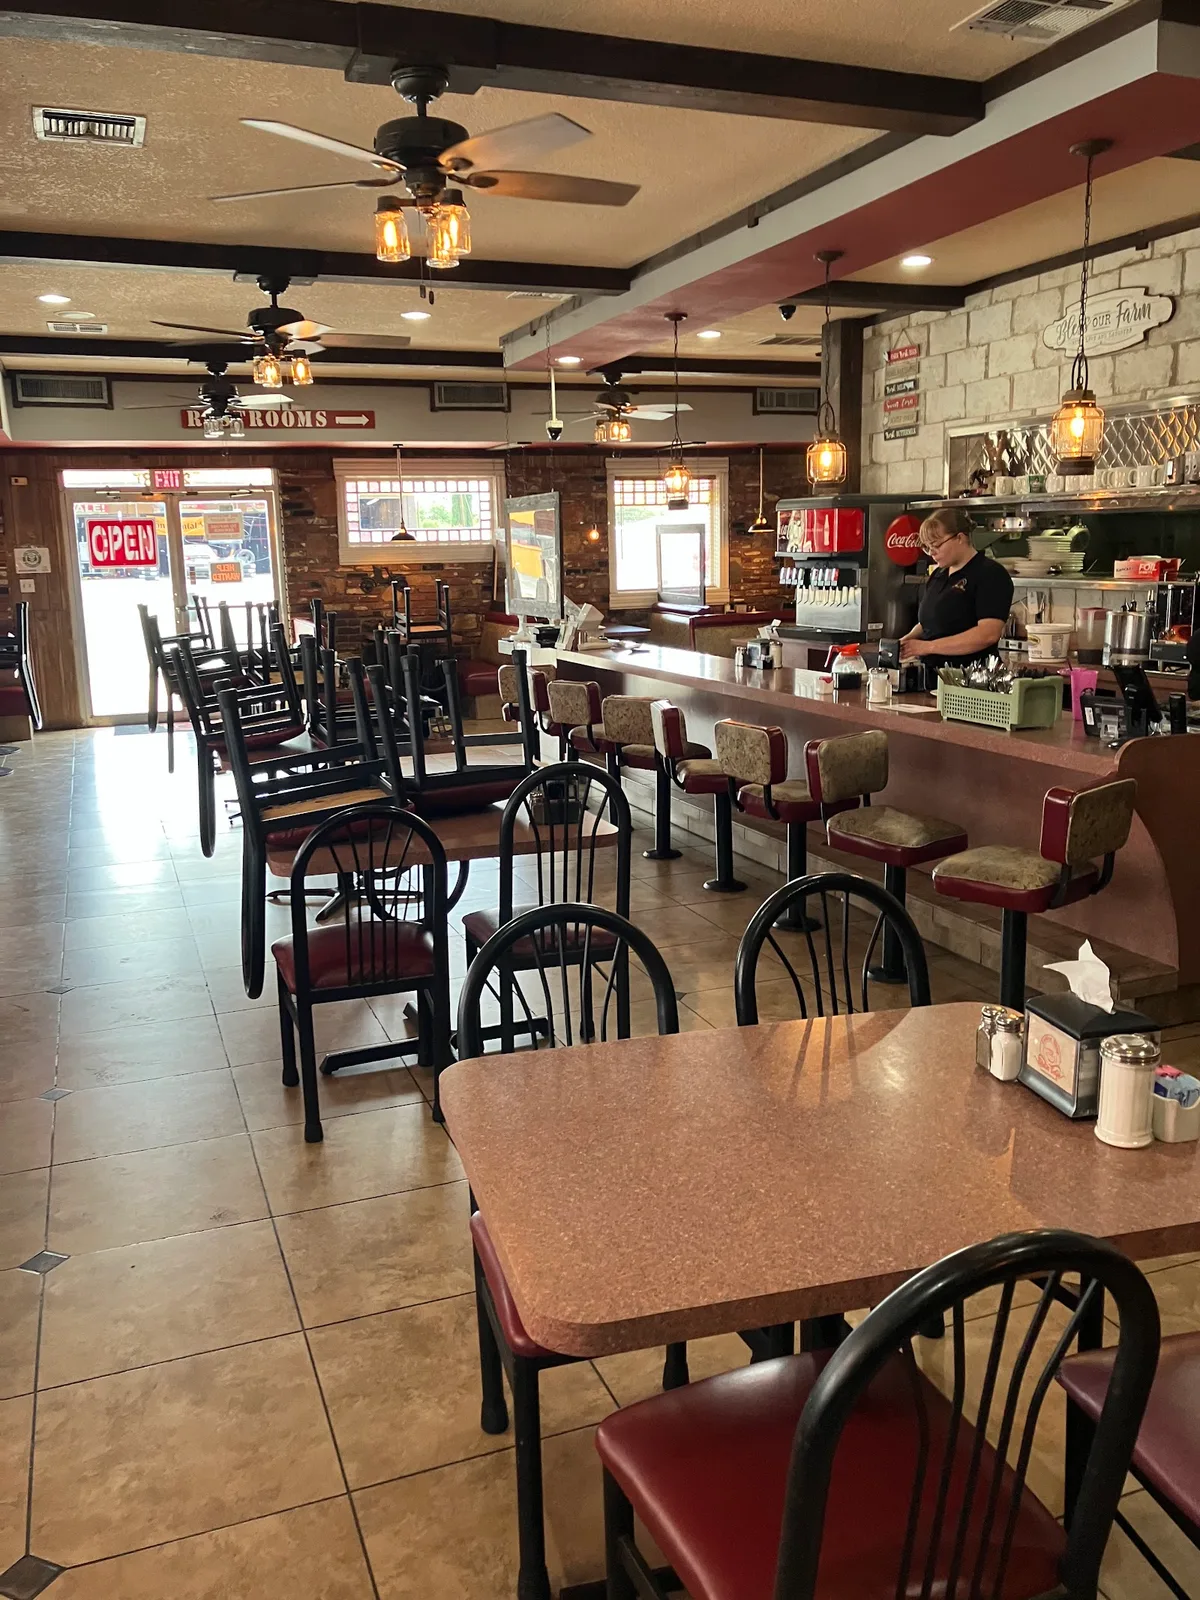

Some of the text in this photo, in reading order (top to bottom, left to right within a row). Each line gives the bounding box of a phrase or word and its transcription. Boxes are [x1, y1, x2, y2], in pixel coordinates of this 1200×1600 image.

[1092, 314, 1111, 328] OUR
[1116, 299, 1151, 328] Farm
[154, 470, 180, 488] EXIT
[75, 503, 105, 513] ALE!
[91, 524, 155, 562] OPEN
[1139, 563, 1157, 572] FOIL
